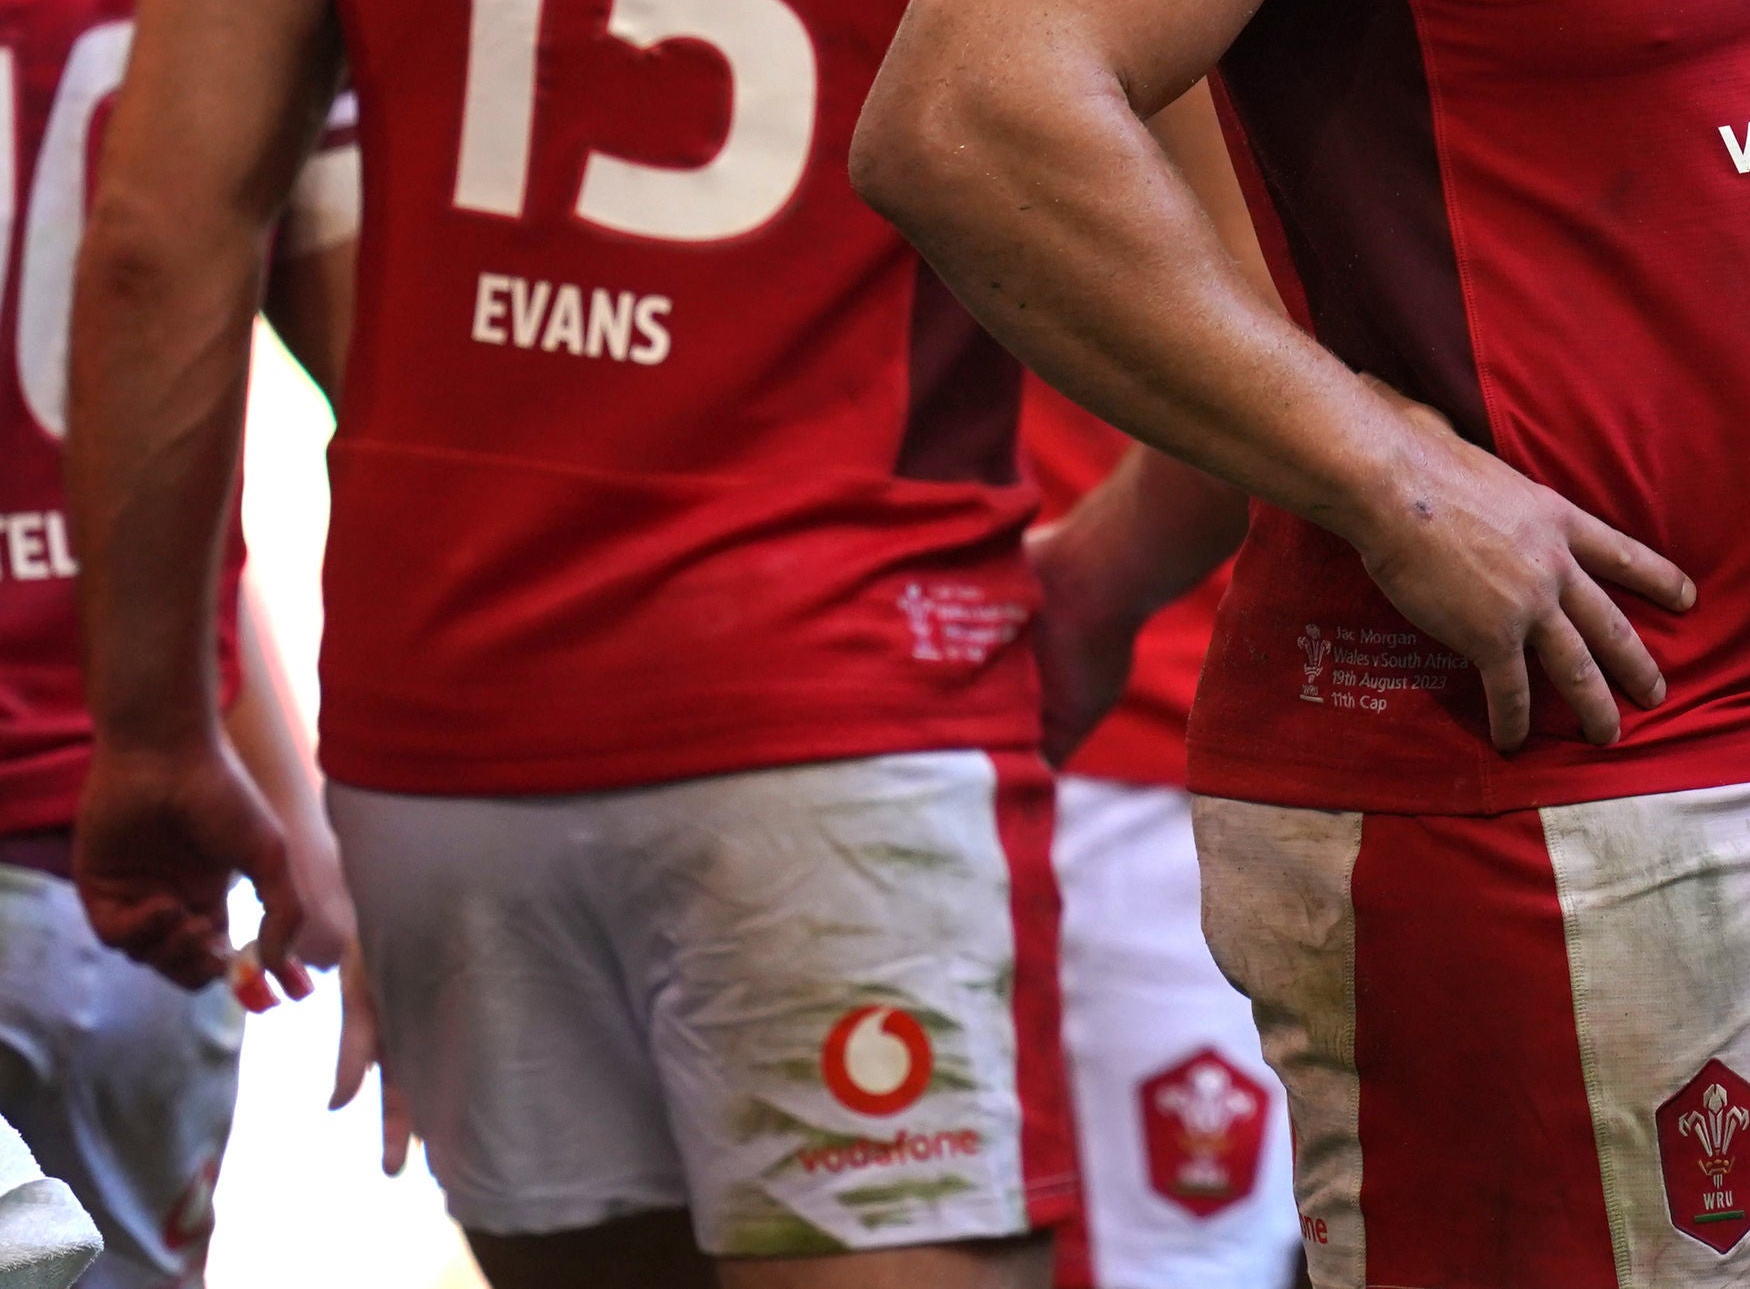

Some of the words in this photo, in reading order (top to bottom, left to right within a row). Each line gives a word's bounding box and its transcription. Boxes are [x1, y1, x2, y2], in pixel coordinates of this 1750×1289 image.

[472, 274, 672, 366] EVANS
[1336, 626, 1354, 641] Jac
[1360, 629, 1416, 648] Morgan
[1334, 647, 1369, 666] Wales
[1372, 655, 1379, 667] v
[1381, 653, 1420, 668] South
[1424, 653, 1468, 669] Africa
[1333, 670, 1356, 686] 19th
[1359, 672, 1407, 693] August
[1411, 675, 1446, 690] 2023
[1331, 692, 1355, 708] 11th
[1360, 695, 1387, 715] Cap
[797, 1129, 981, 1175] vodafone
[1703, 1191, 1733, 1210] WRU
